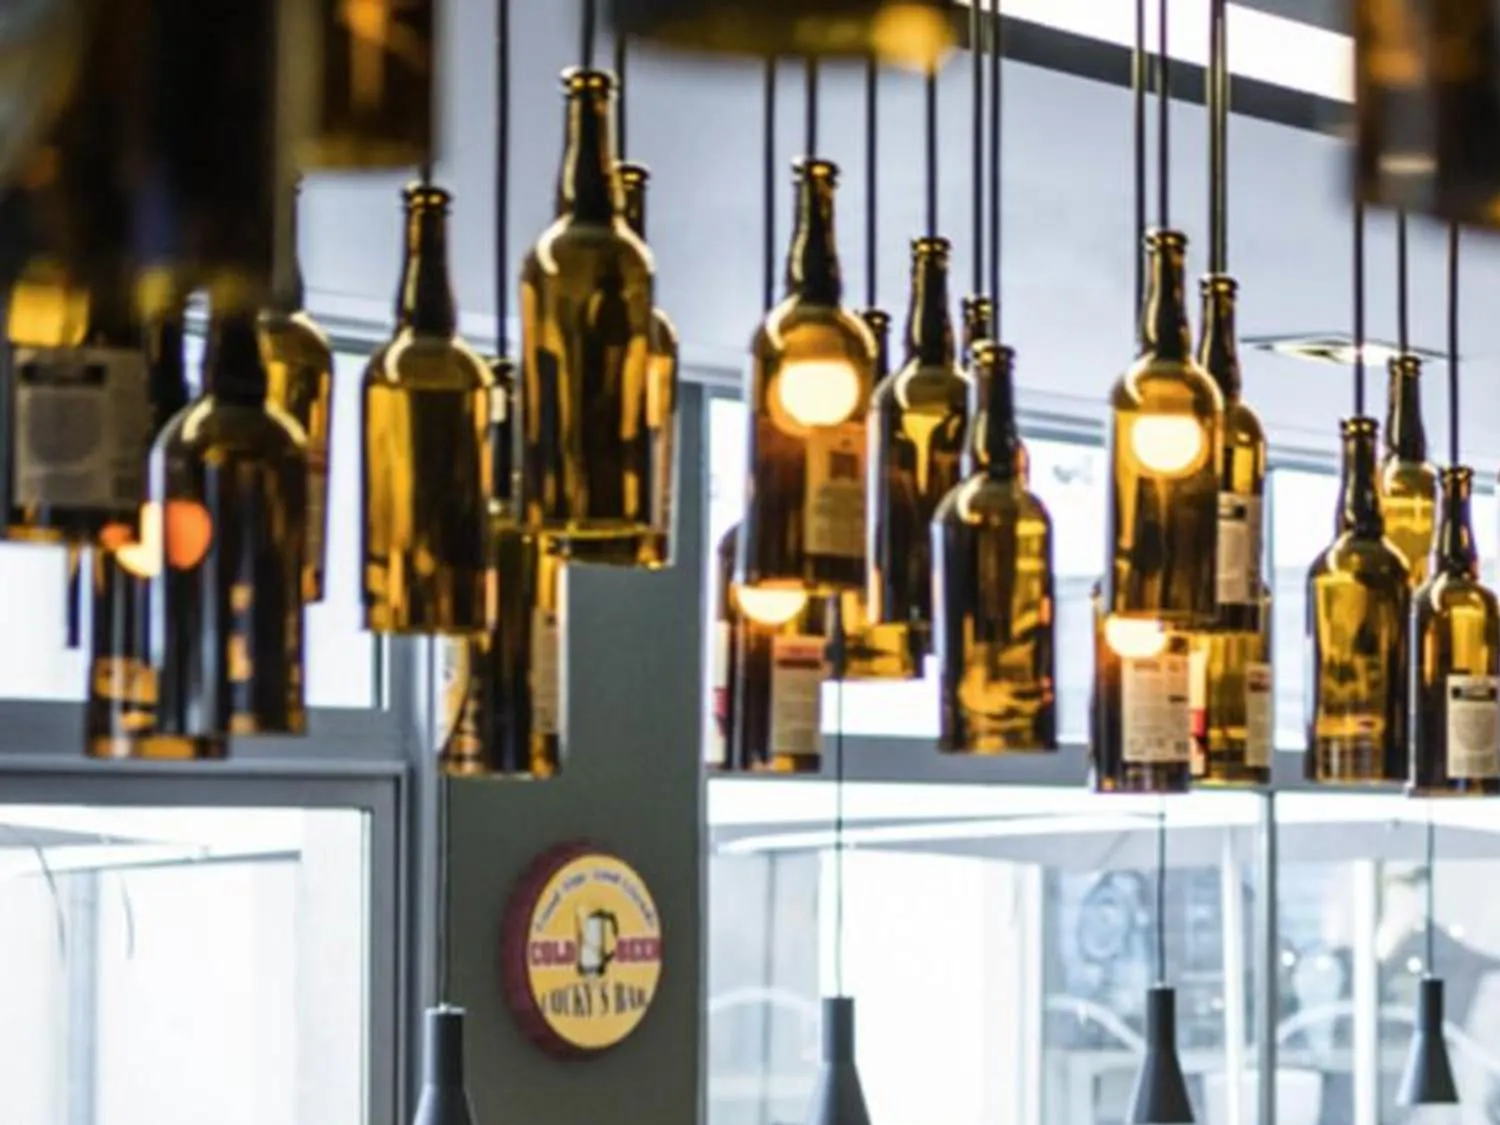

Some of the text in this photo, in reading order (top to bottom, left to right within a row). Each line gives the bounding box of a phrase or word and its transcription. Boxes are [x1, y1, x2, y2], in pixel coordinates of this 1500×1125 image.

[529, 937, 661, 966] COLD BEER
[615, 983, 648, 1014] BAR
